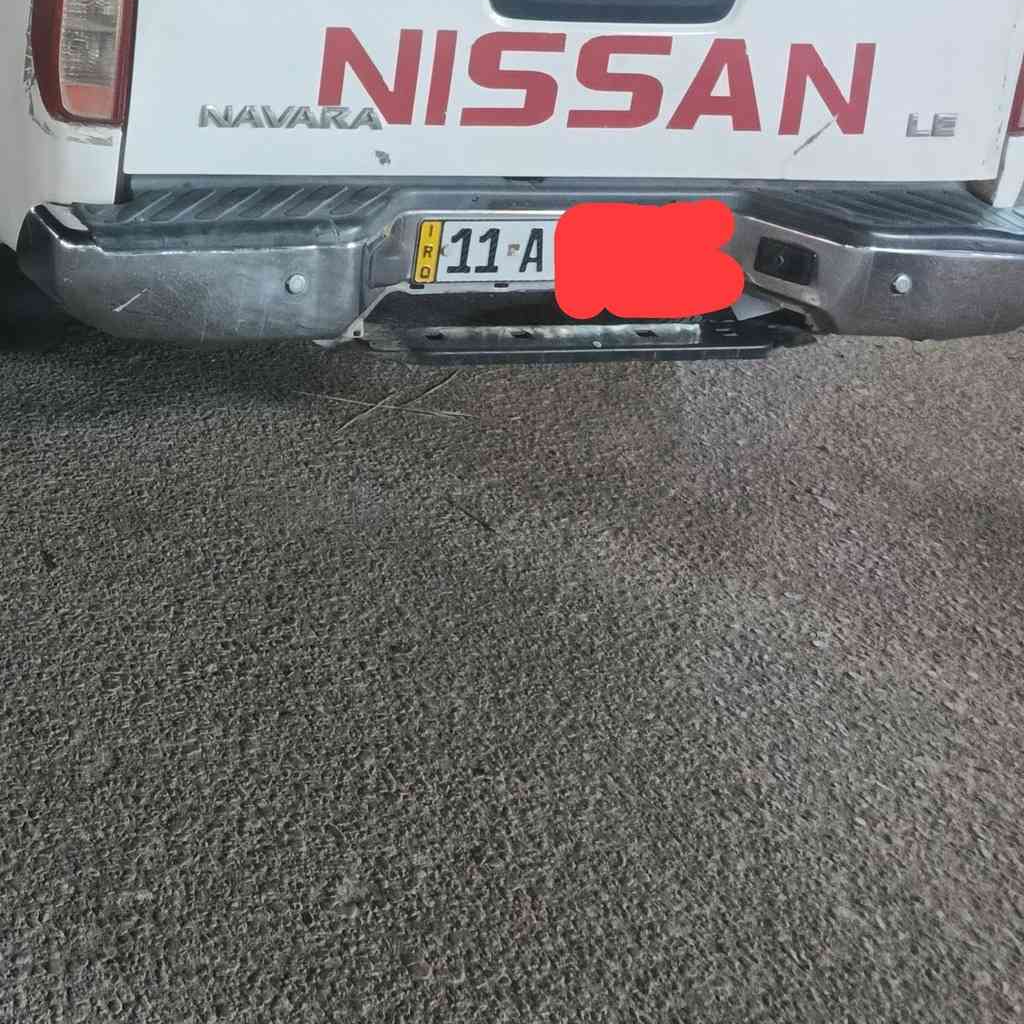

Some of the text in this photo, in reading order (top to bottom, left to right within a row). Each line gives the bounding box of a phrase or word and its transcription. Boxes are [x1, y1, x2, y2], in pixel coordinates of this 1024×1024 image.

[318, 27, 876, 135] NISSAN
[198, 105, 382, 130] NAVARA
[906, 113, 958, 137] LE
[446, 227, 545, 274] 11 A
